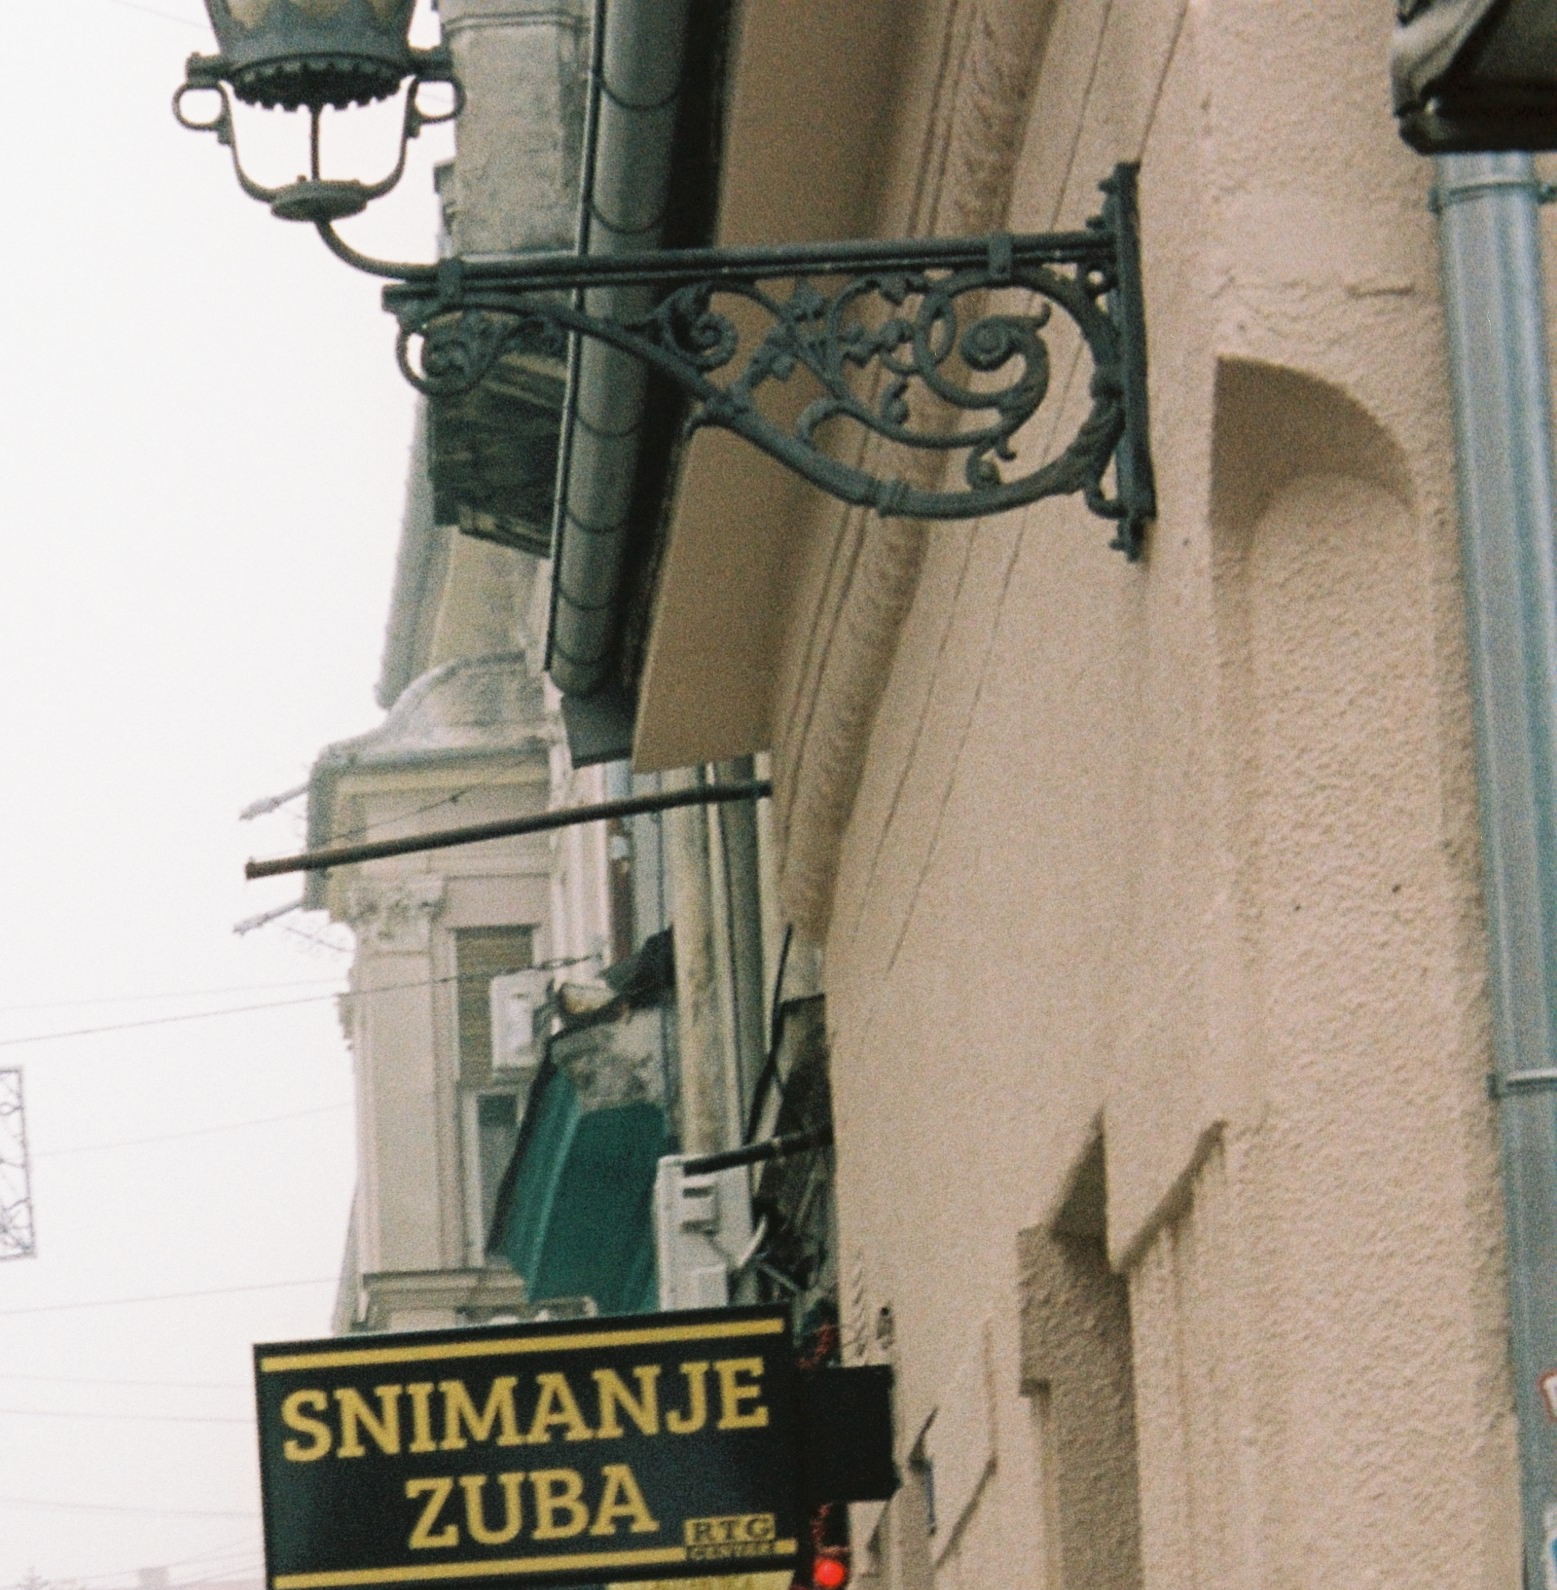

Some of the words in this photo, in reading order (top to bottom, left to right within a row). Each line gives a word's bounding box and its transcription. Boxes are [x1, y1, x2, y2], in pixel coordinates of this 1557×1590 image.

[280, 1355, 770, 1463] SNIMANJE
[405, 1463, 660, 1550] ZUBA
[692, 1517, 771, 1542] RTG
